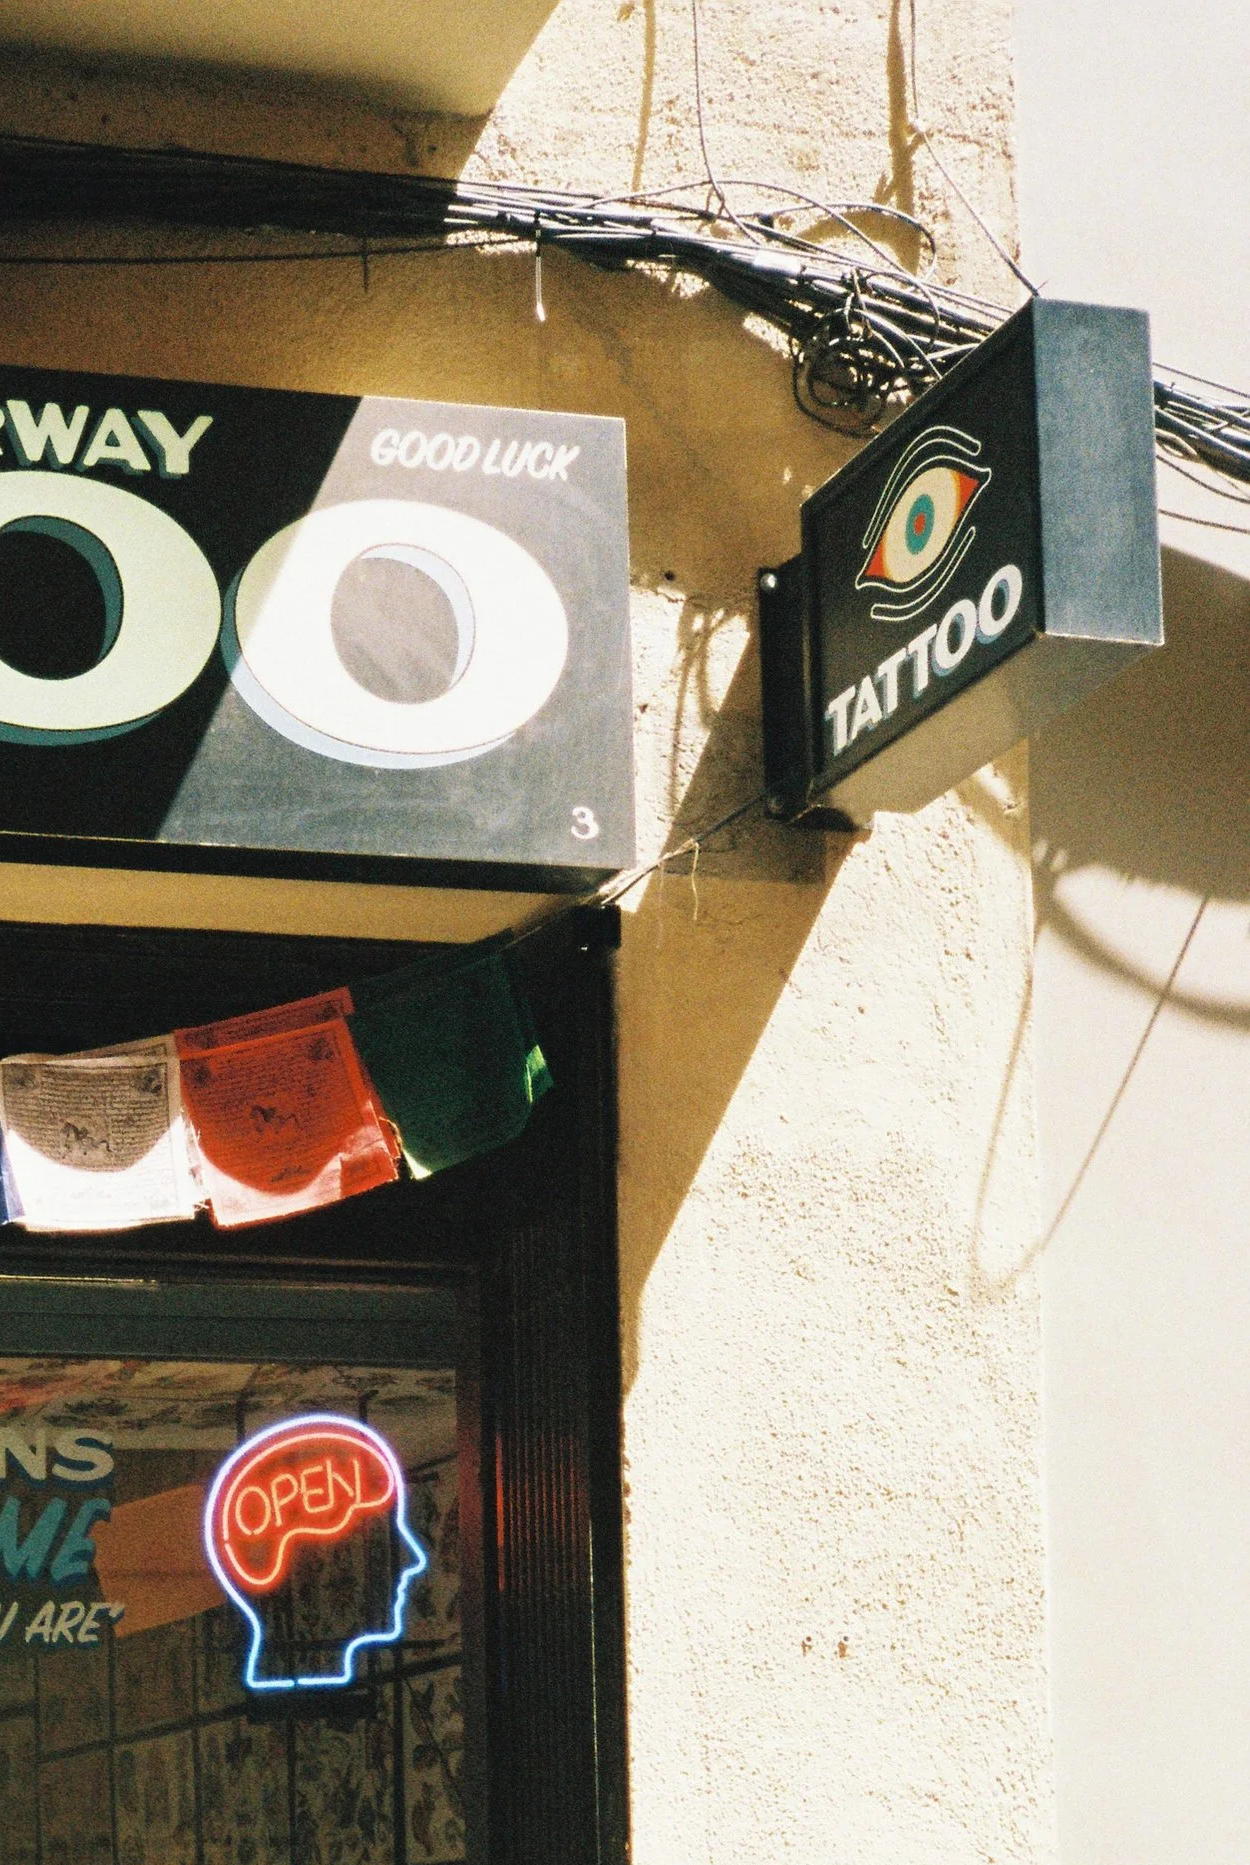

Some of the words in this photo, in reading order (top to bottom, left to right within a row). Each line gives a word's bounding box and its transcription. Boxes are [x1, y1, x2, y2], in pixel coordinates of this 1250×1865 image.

[369, 427, 481, 474] GOOD
[481, 437, 580, 482] LUCK
[823, 563, 1024, 758] TATTOO
[570, 805, 600, 840] 3
[235, 1457, 361, 1536] OPEN
